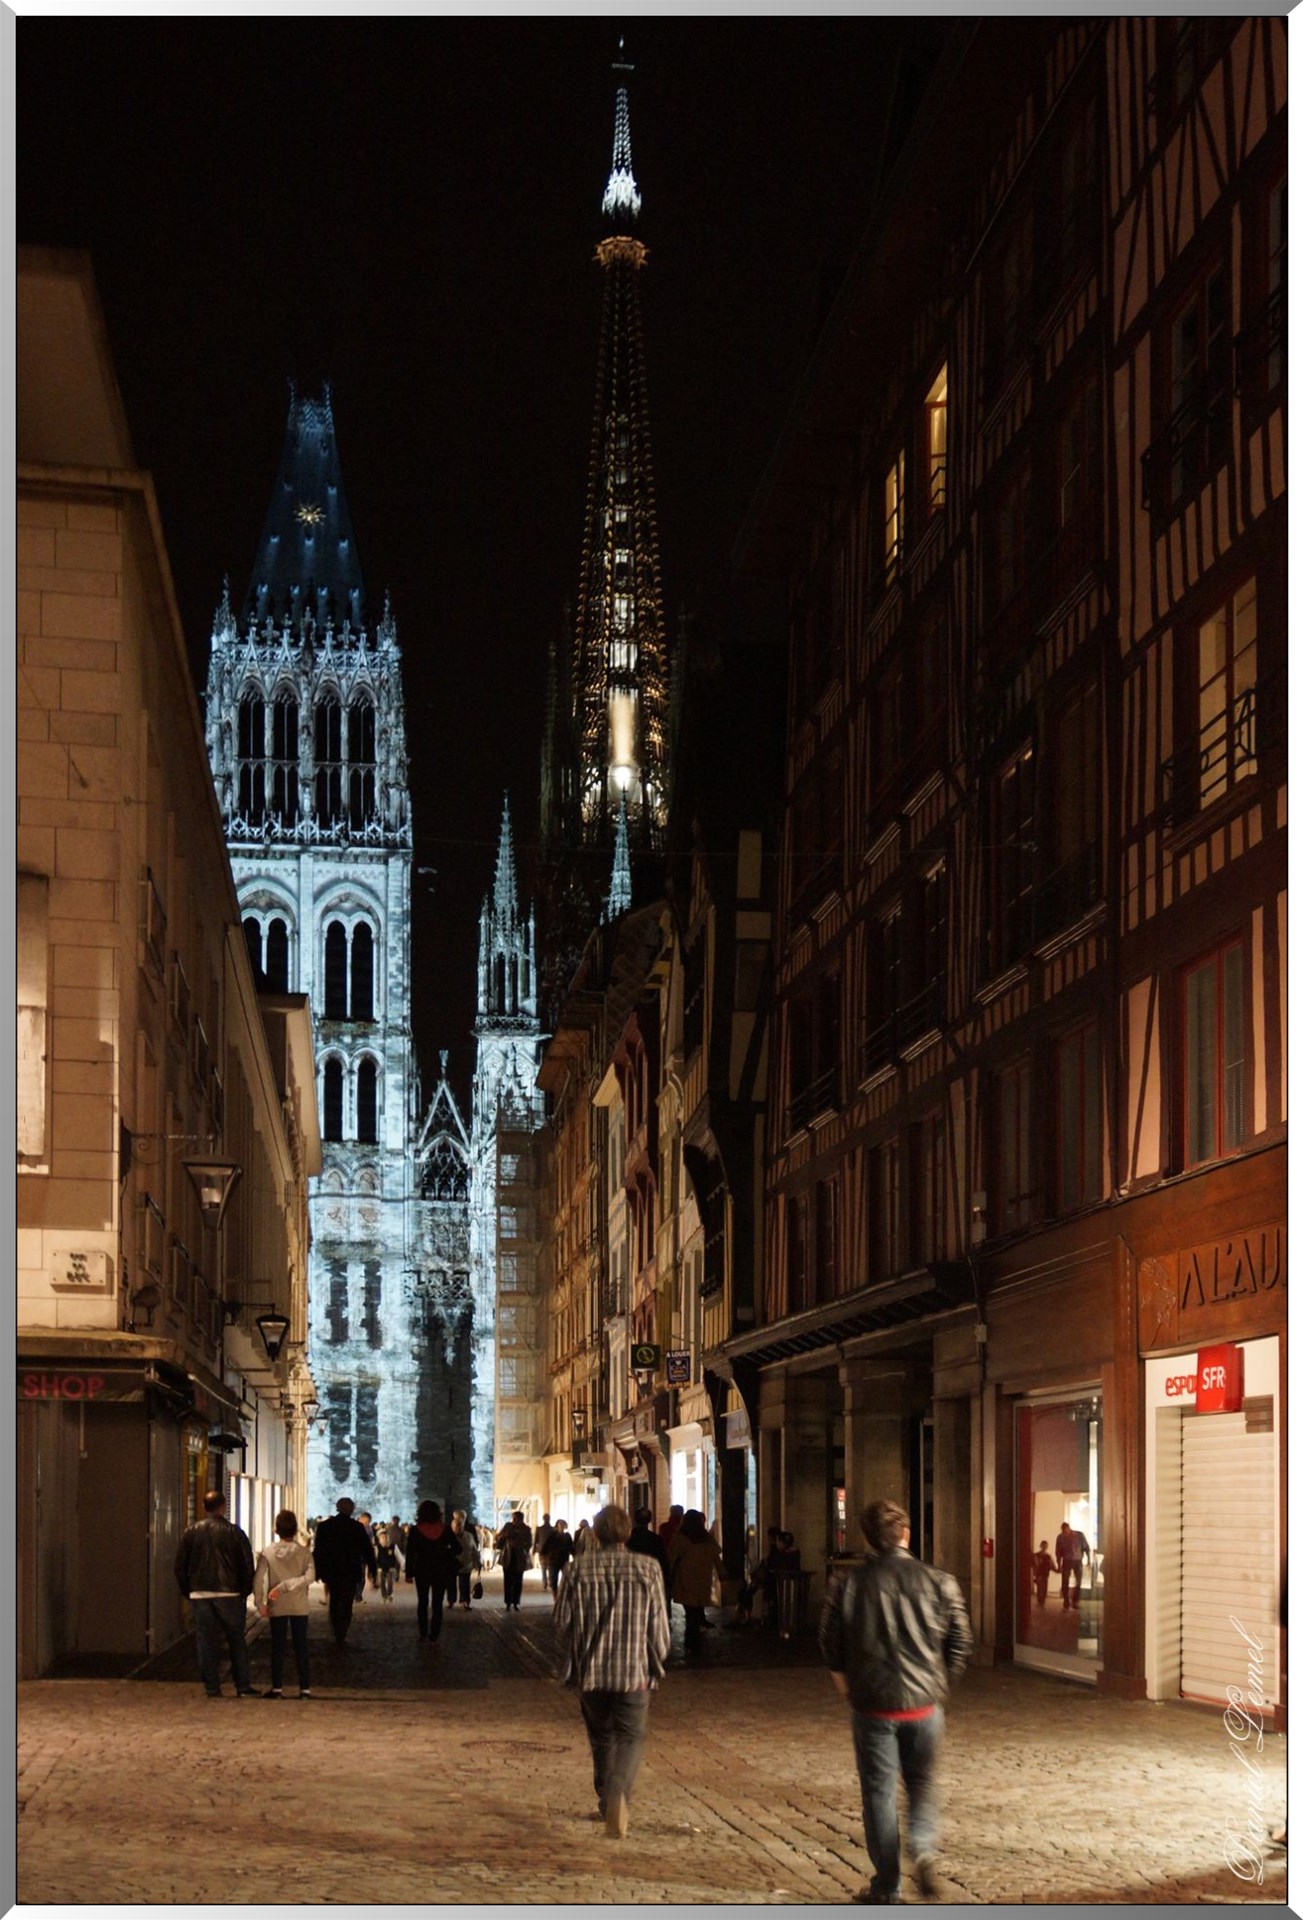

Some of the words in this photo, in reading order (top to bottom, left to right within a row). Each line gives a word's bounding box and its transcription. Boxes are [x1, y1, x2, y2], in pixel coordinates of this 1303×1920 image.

[1182, 1253, 1204, 1309] A
[1209, 1228, 1285, 1303] L'AU
[24, 1374, 104, 1399] SHOP
[1202, 1365, 1226, 1390] SFR
